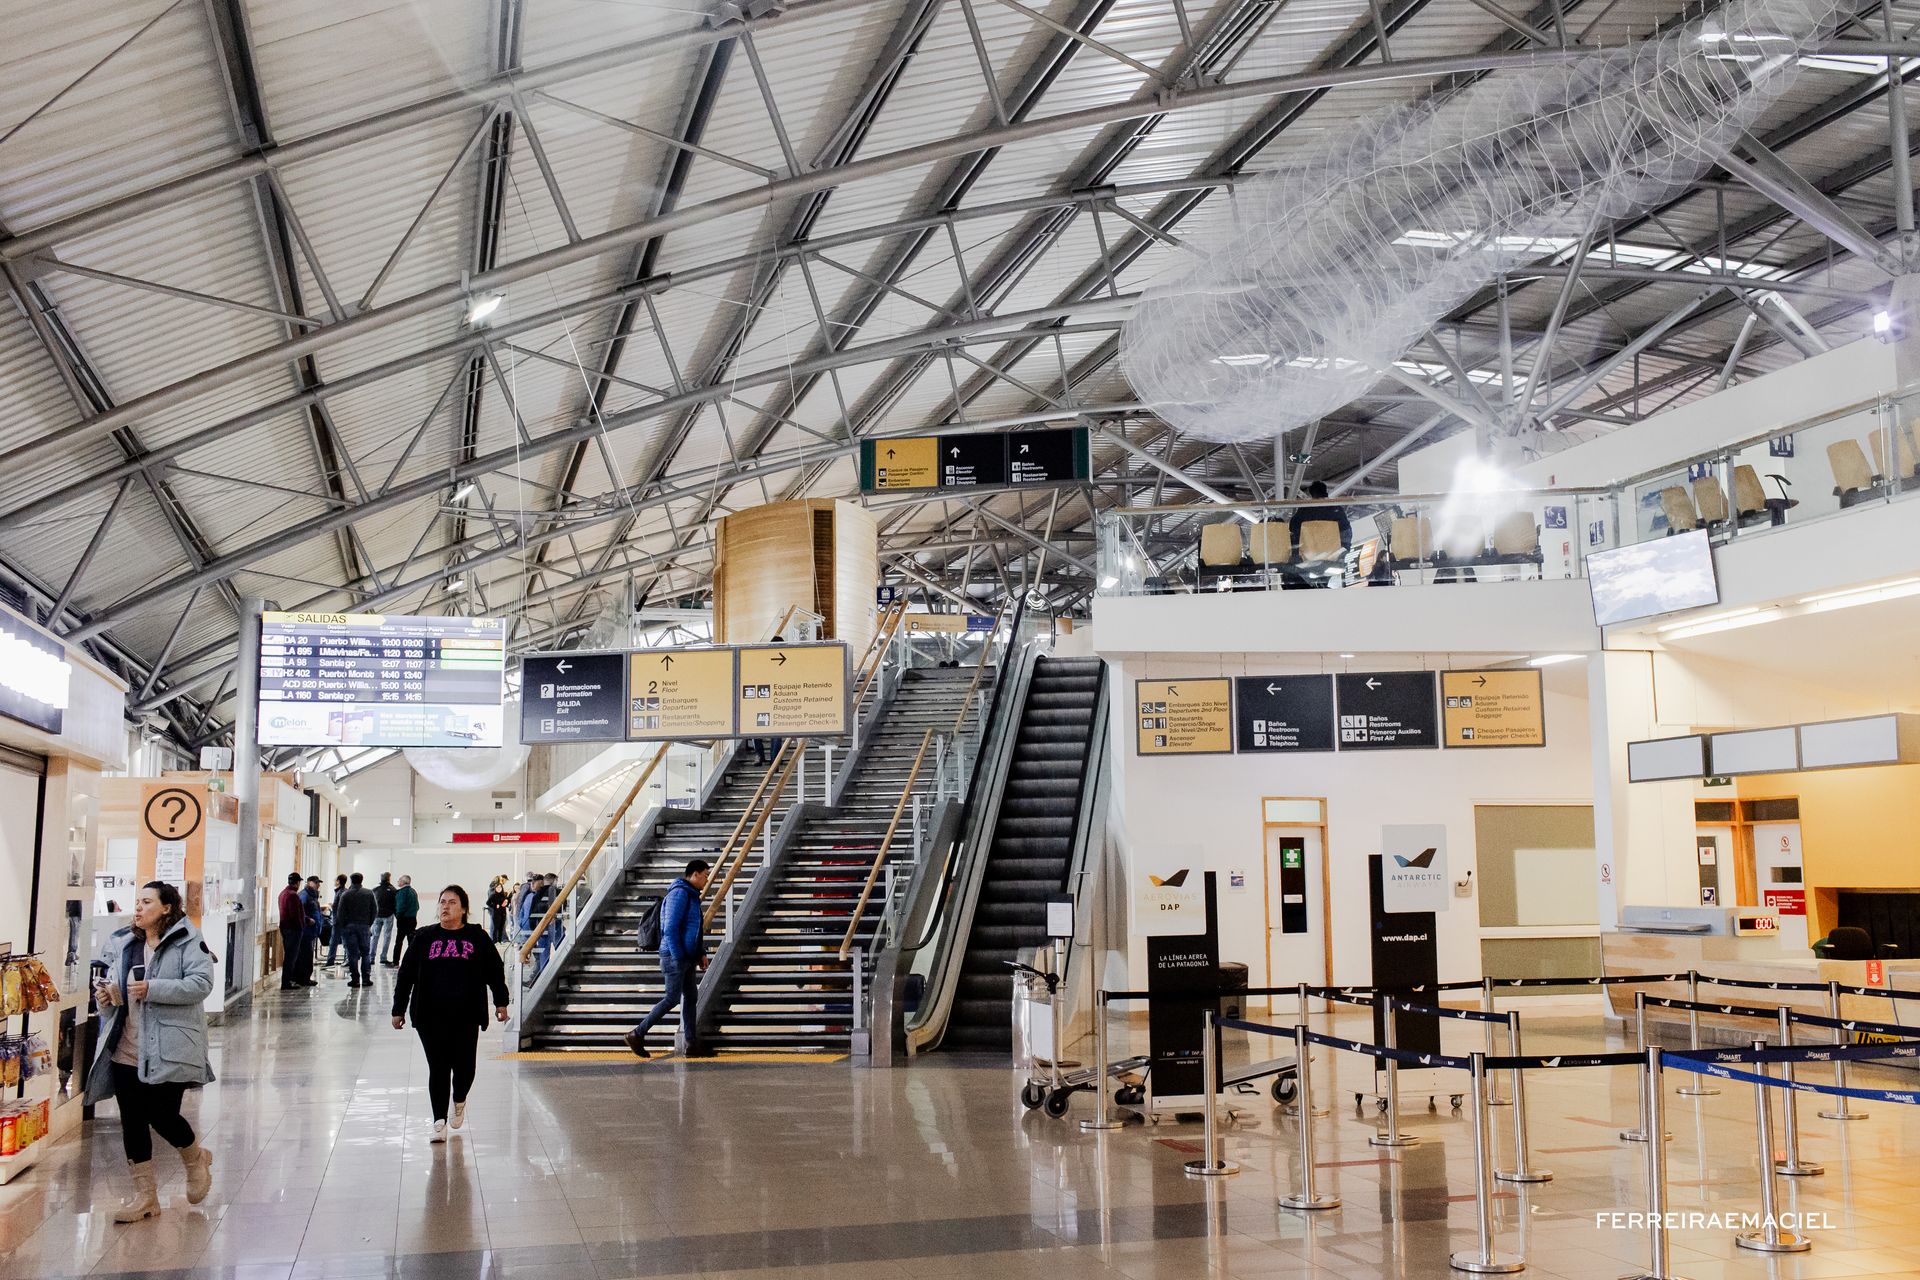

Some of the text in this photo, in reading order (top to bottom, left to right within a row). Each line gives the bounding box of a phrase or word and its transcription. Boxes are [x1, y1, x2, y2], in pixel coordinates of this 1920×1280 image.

[297, 614, 346, 624] SALIDAS
[298, 636, 308, 645] 20
[320, 637, 348, 645] Puerto
[381, 639, 400, 647] 10:00
[402, 639, 423, 647] 09:00
[284, 647, 296, 655] LA
[383, 650, 400, 658] 11:20
[404, 650, 423, 658] 10:20
[283, 658, 295, 666] LA
[319, 659, 356, 669] Santiago
[406, 661, 423, 669] 11:07
[295, 669, 310, 677] 402
[319, 669, 347, 678] Puerto
[348, 670, 374, 678] Montt
[381, 671, 400, 679] 14:40
[403, 671, 422, 680] 13:40
[318, 681, 347, 689] Puerto
[403, 682, 422, 690] 14:00
[648, 681, 657, 694] 2
[282, 691, 294, 699] LA
[318, 692, 355, 702] Santiago
[405, 693, 422, 701] 14:15
[1756, 919, 1772, 928] 000
[1382, 933, 1427, 942] www.dap.cl
[428, 940, 474, 960] GAP
